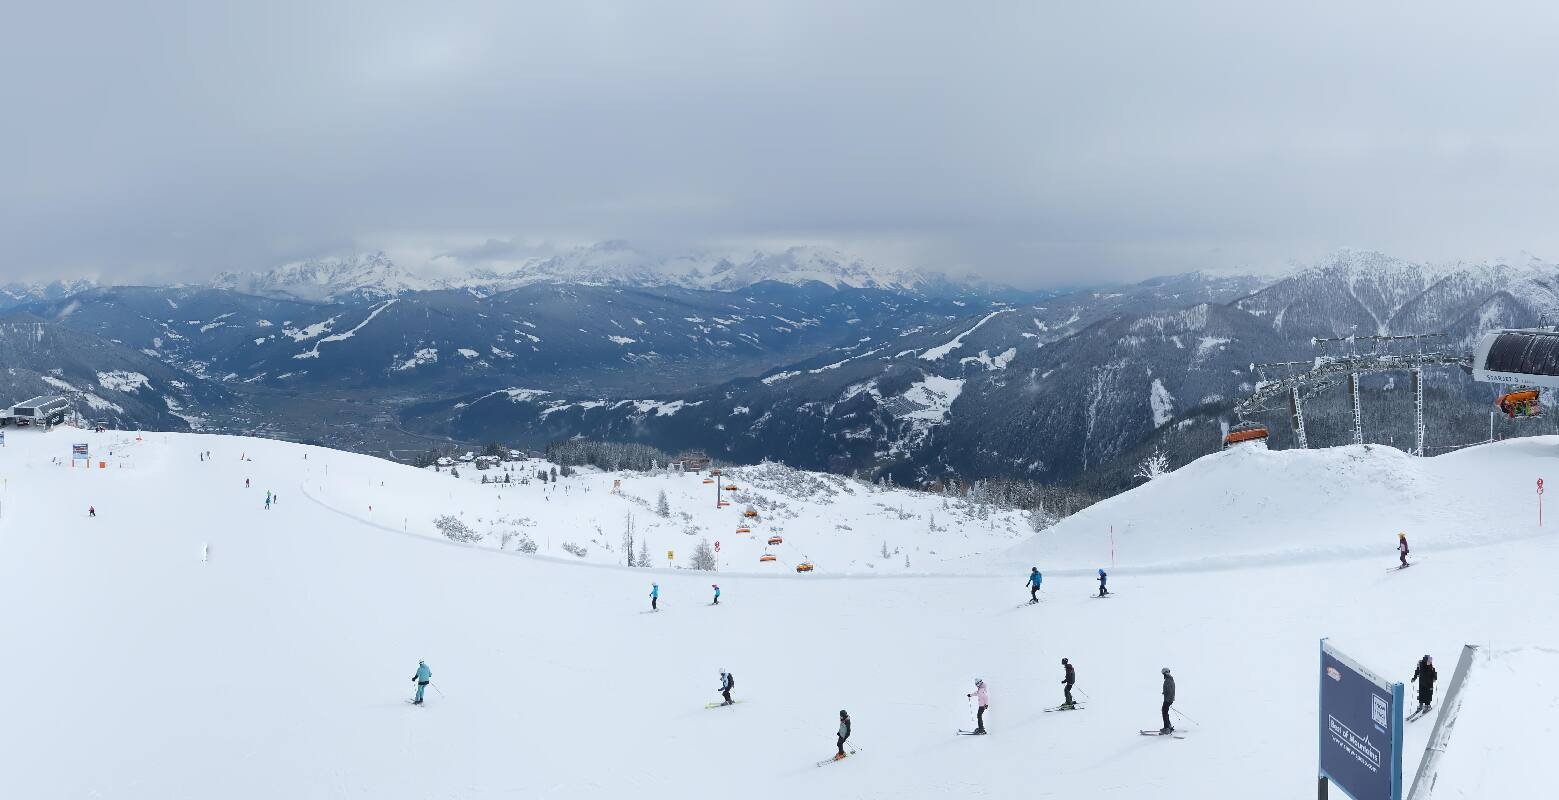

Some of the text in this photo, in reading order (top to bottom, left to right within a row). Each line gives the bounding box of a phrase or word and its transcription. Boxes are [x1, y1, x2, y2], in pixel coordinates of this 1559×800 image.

[1330, 719, 1379, 762] Best of Mountains
